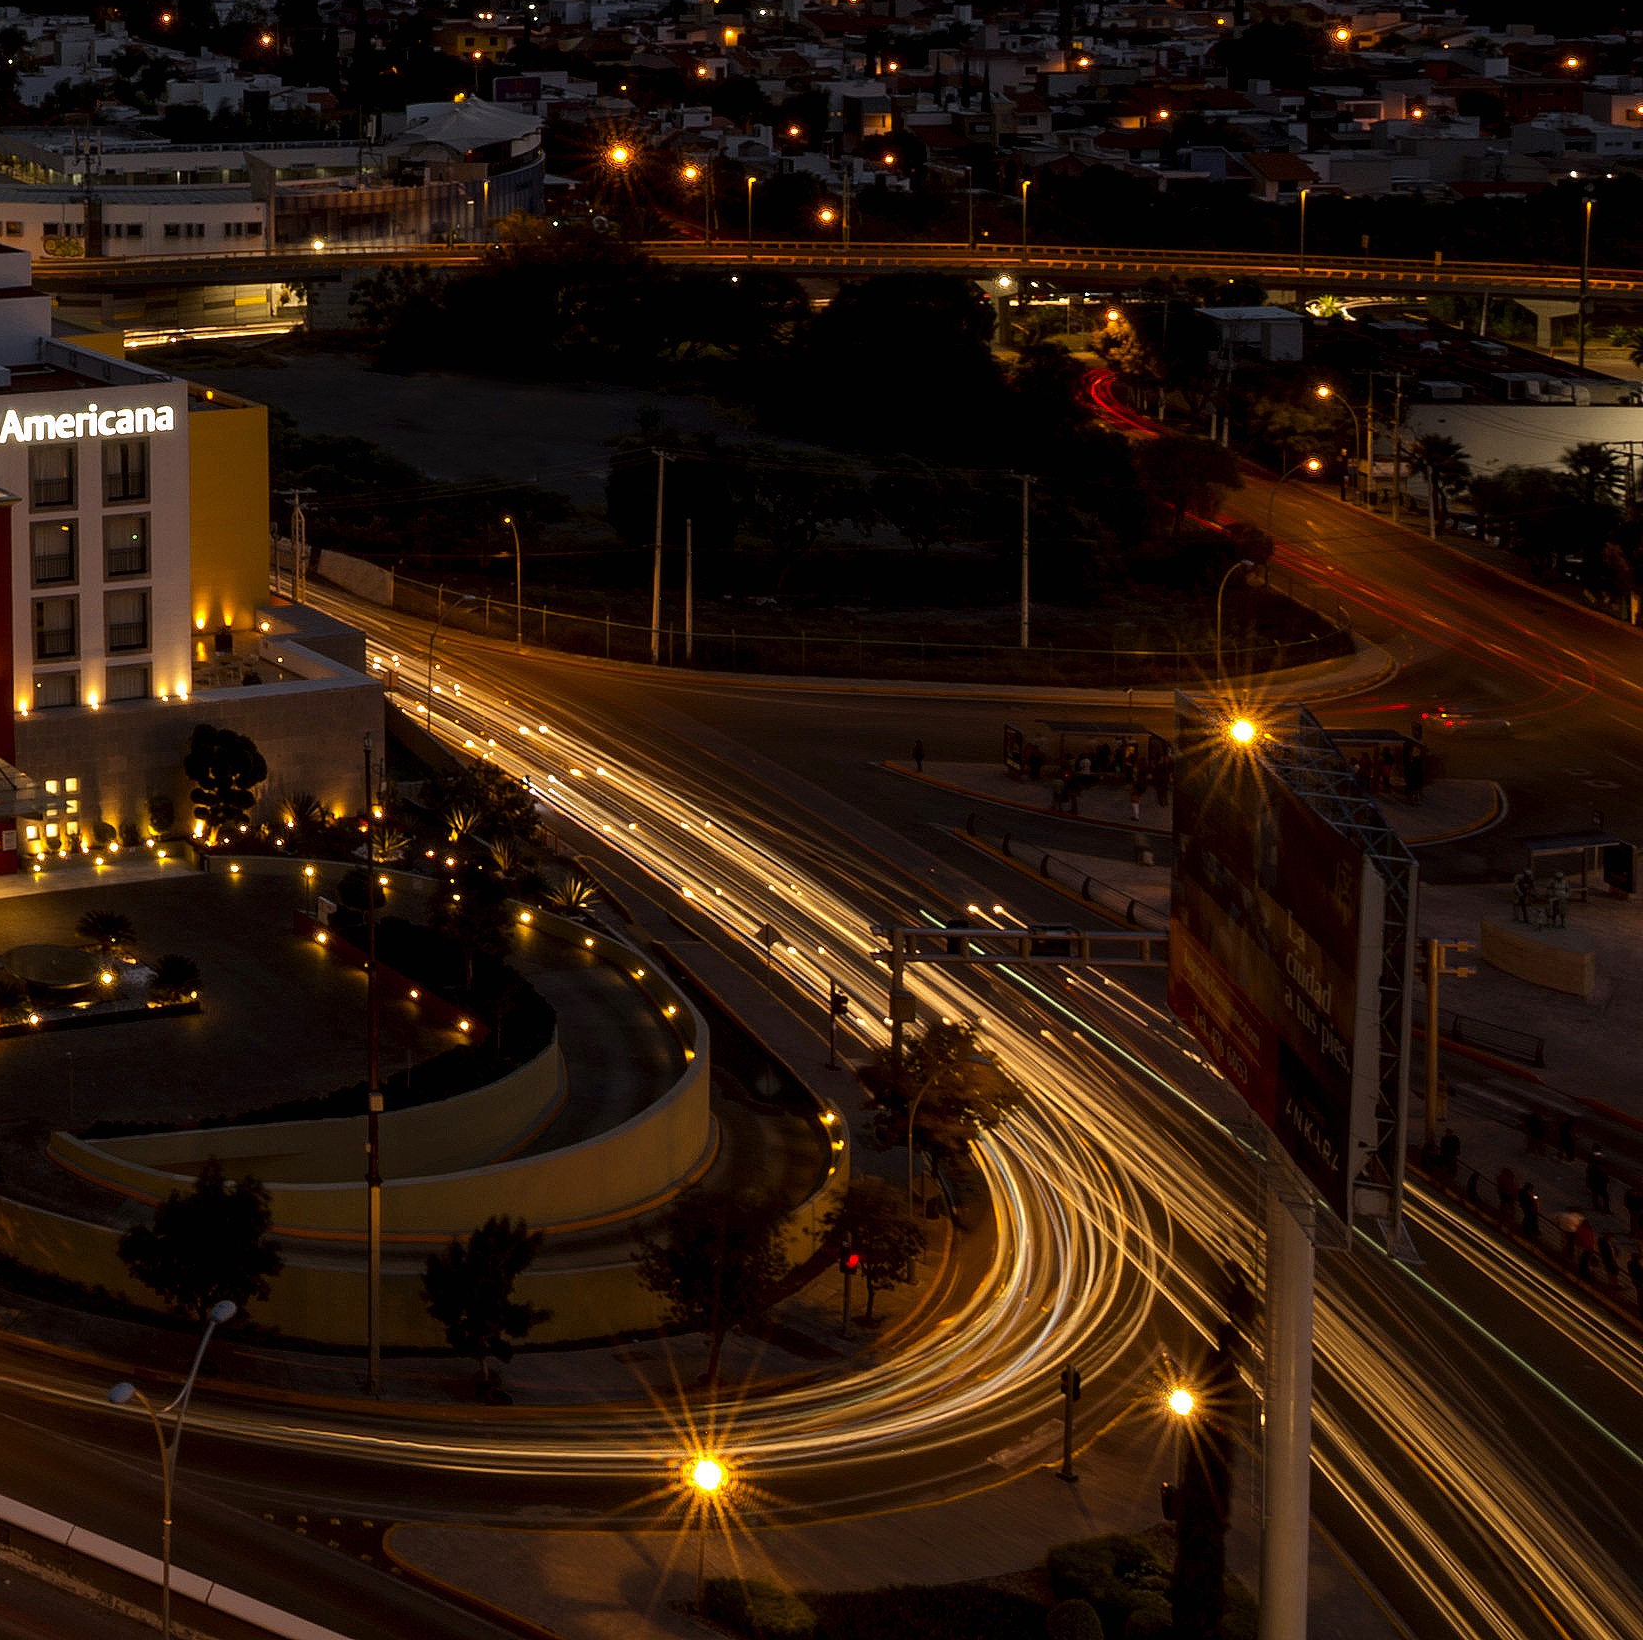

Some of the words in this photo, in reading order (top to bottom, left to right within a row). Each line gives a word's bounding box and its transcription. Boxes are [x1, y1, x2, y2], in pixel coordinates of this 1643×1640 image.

[1285, 948, 1332, 1015] ciudad
[1285, 985, 1294, 1010] a
[1296, 994, 1318, 1036] tus
[1320, 1023, 1351, 1074] pies.
